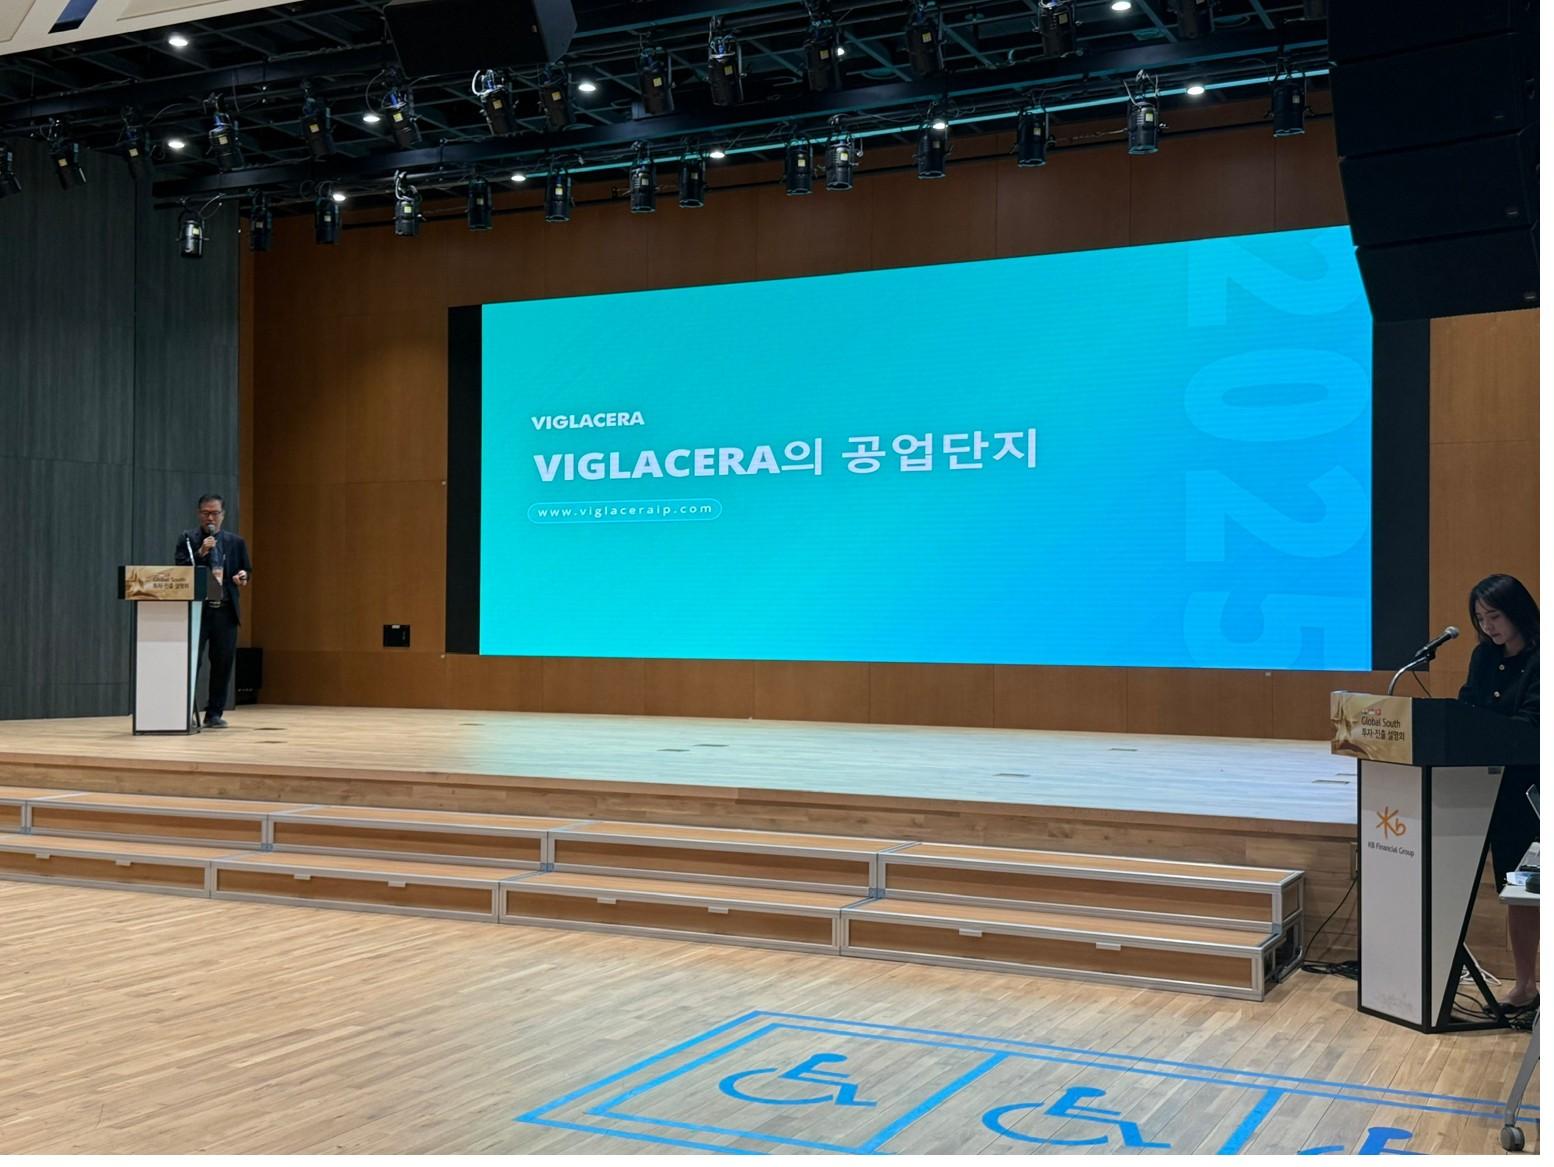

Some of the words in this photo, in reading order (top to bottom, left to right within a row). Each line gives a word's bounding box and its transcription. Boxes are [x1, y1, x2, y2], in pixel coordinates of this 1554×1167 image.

[531, 411, 645, 431] VIGLACERA
[534, 435, 823, 483] VIGLACERA의
[842, 428, 1039, 474] 공업단지
[537, 503, 713, 520] www.viglaceraip.com
[1361, 716, 1382, 727] Global
[1383, 718, 1401, 729] South
[1375, 842, 1398, 854] Financial
[1398, 846, 1415, 858] Group
